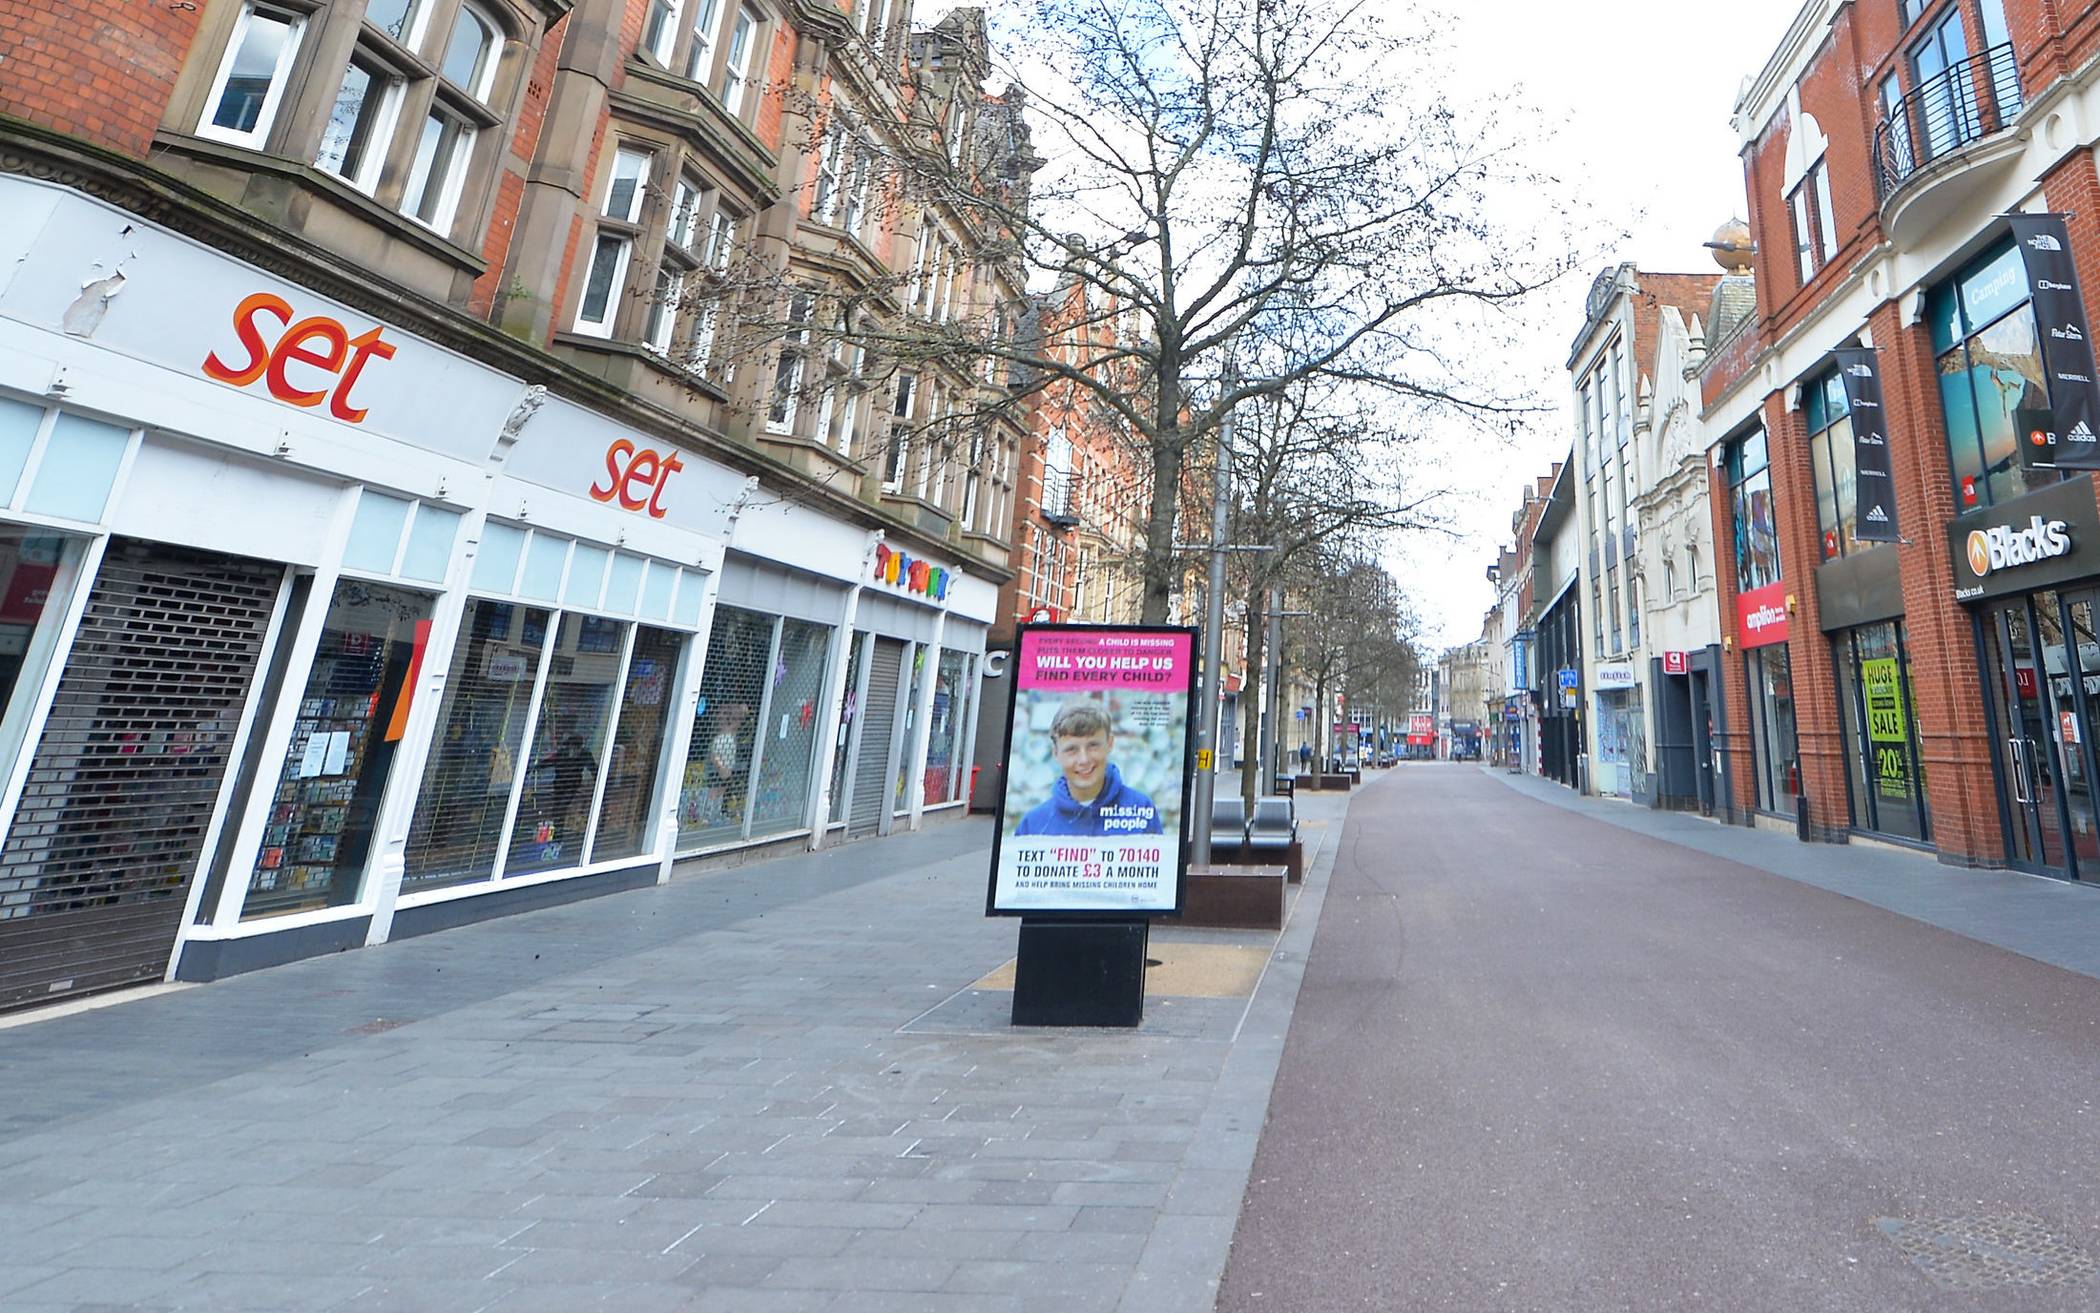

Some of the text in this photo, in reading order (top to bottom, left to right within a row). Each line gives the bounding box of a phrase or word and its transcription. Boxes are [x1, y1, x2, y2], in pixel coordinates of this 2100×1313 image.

[1971, 267, 2016, 305] Camping
[201, 291, 397, 424] set
[2067, 434, 2097, 443] adidas
[589, 438, 684, 520] set
[1988, 515, 2071, 570] Blacks
[1106, 638, 1129, 646] CHILD
[1140, 639, 1174, 647] MISSING
[1036, 655, 1173, 670] WILL YOU HELP US
[1036, 670, 1172, 682] FIND EVERY CHILD?
[1868, 665, 1892, 685] HUGE
[1873, 712, 1899, 735] SALE
[1100, 804, 1154, 819] missing
[1104, 818, 1148, 831] people
[1018, 848, 1160, 862] TEXT "FIND" TO 70140
[1017, 864, 1159, 878] TO DONATE £3 A MONTH
[1072, 881, 1101, 889] MISSING
[1103, 881, 1136, 889] CHILDREN
